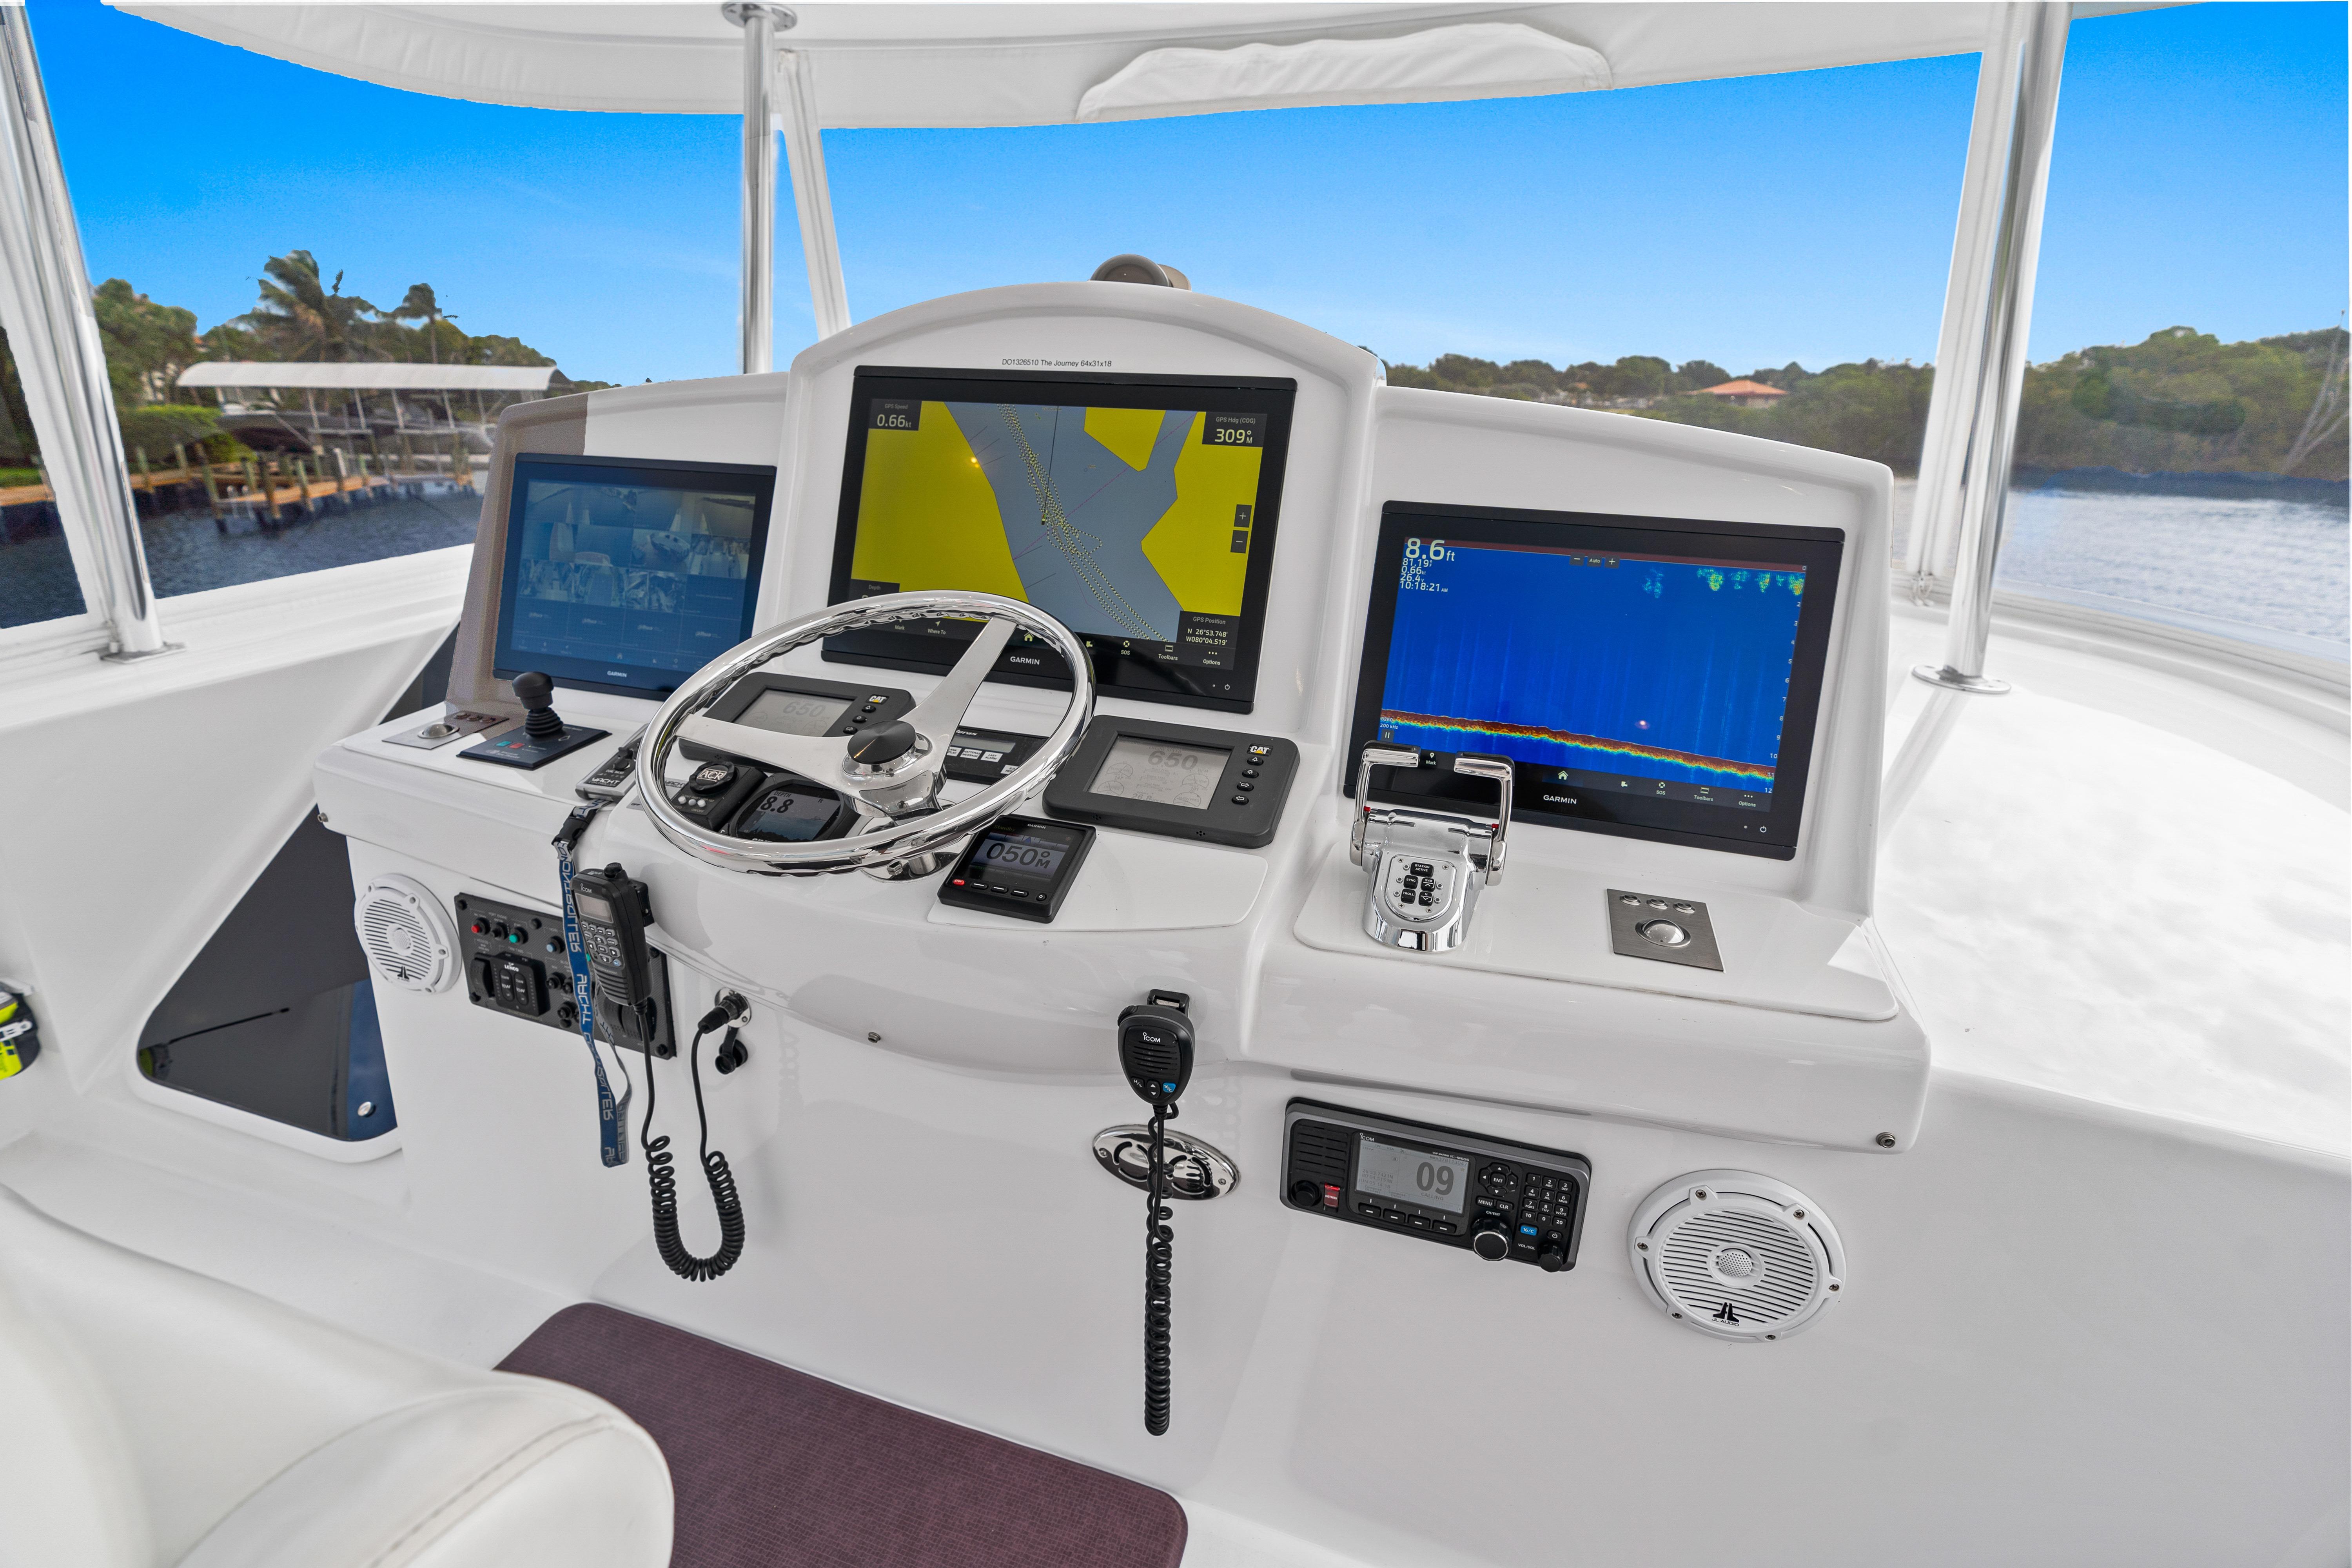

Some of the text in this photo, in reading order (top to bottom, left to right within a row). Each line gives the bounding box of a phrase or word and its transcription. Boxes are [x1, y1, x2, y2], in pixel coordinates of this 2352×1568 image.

[1010, 656, 1040, 666] GARMIN
[783, 701, 826, 718] 650
[1250, 746, 1269, 755] CAT
[1148, 750, 1198, 771] 650
[702, 770, 724, 780] ACR
[760, 796, 794, 813] 8.8
[1543, 795, 1577, 805] GARMIN
[577, 974, 591, 1025] YACHT
[1134, 1079, 1142, 1087] H/L
[1416, 1161, 1454, 1195] 09
[1421, 1192, 1444, 1201] CALLING
